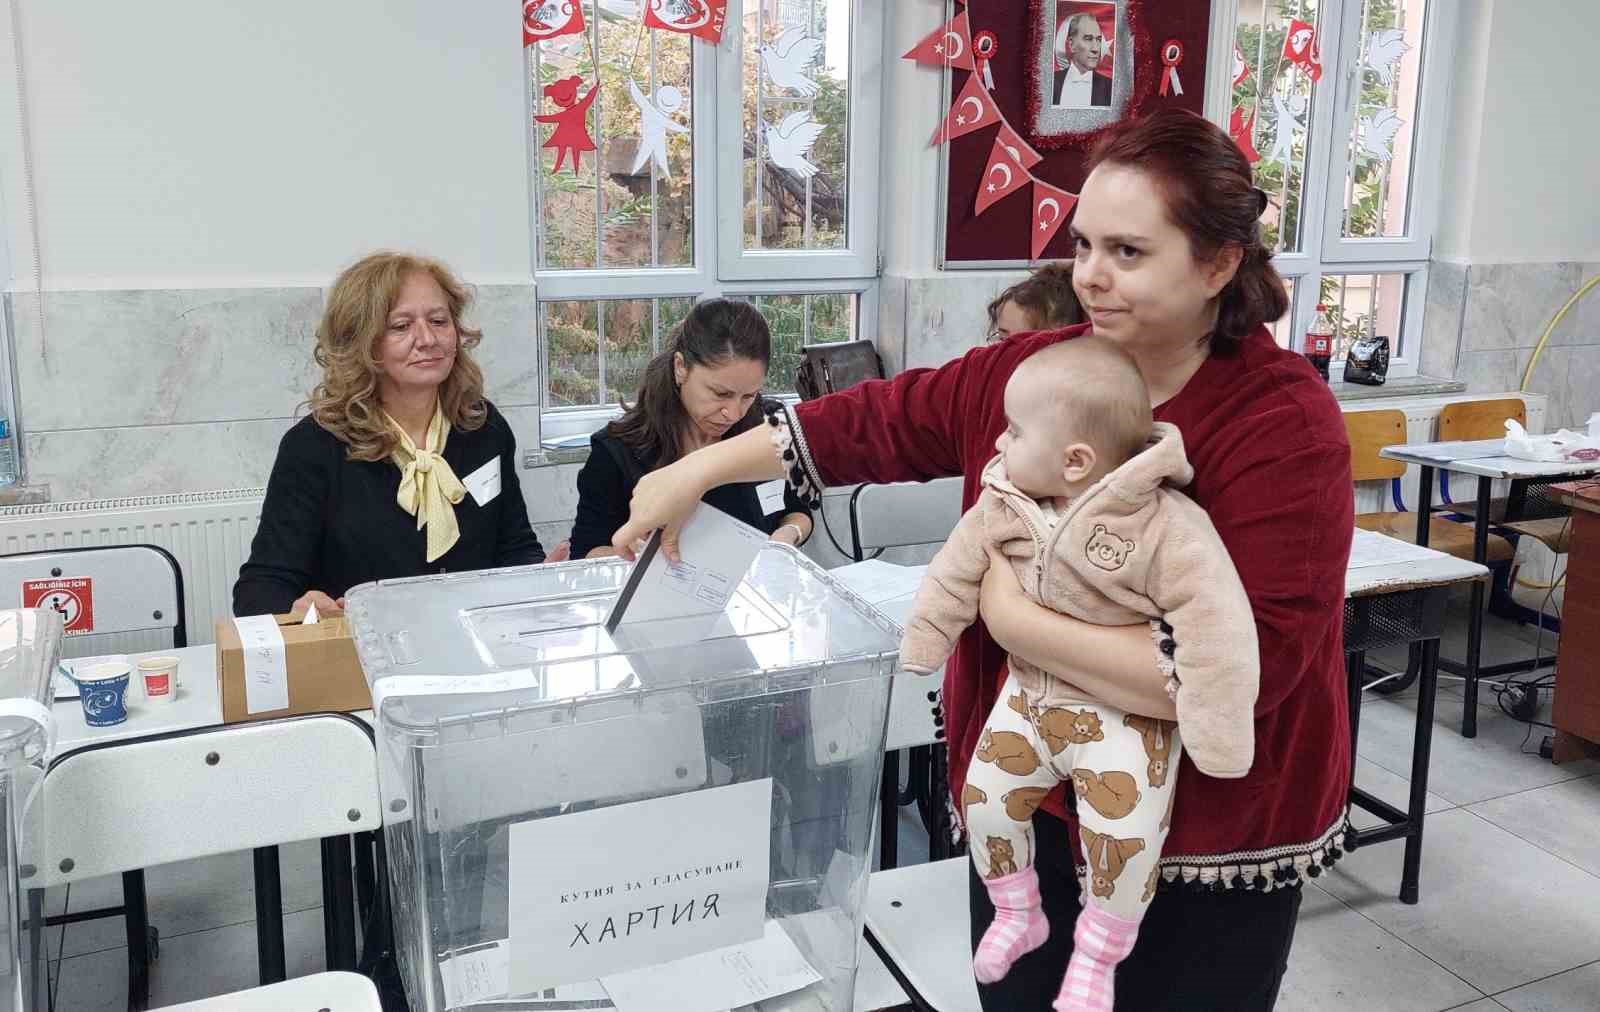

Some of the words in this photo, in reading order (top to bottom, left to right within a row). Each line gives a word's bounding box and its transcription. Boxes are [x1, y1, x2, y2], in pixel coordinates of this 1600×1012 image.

[559, 885, 615, 905] КУТИЯ
[623, 880, 642, 892] ЗА
[652, 860, 742, 886] ГЛАСУВАНЕ
[569, 893, 721, 949] ХАРТИЯ
